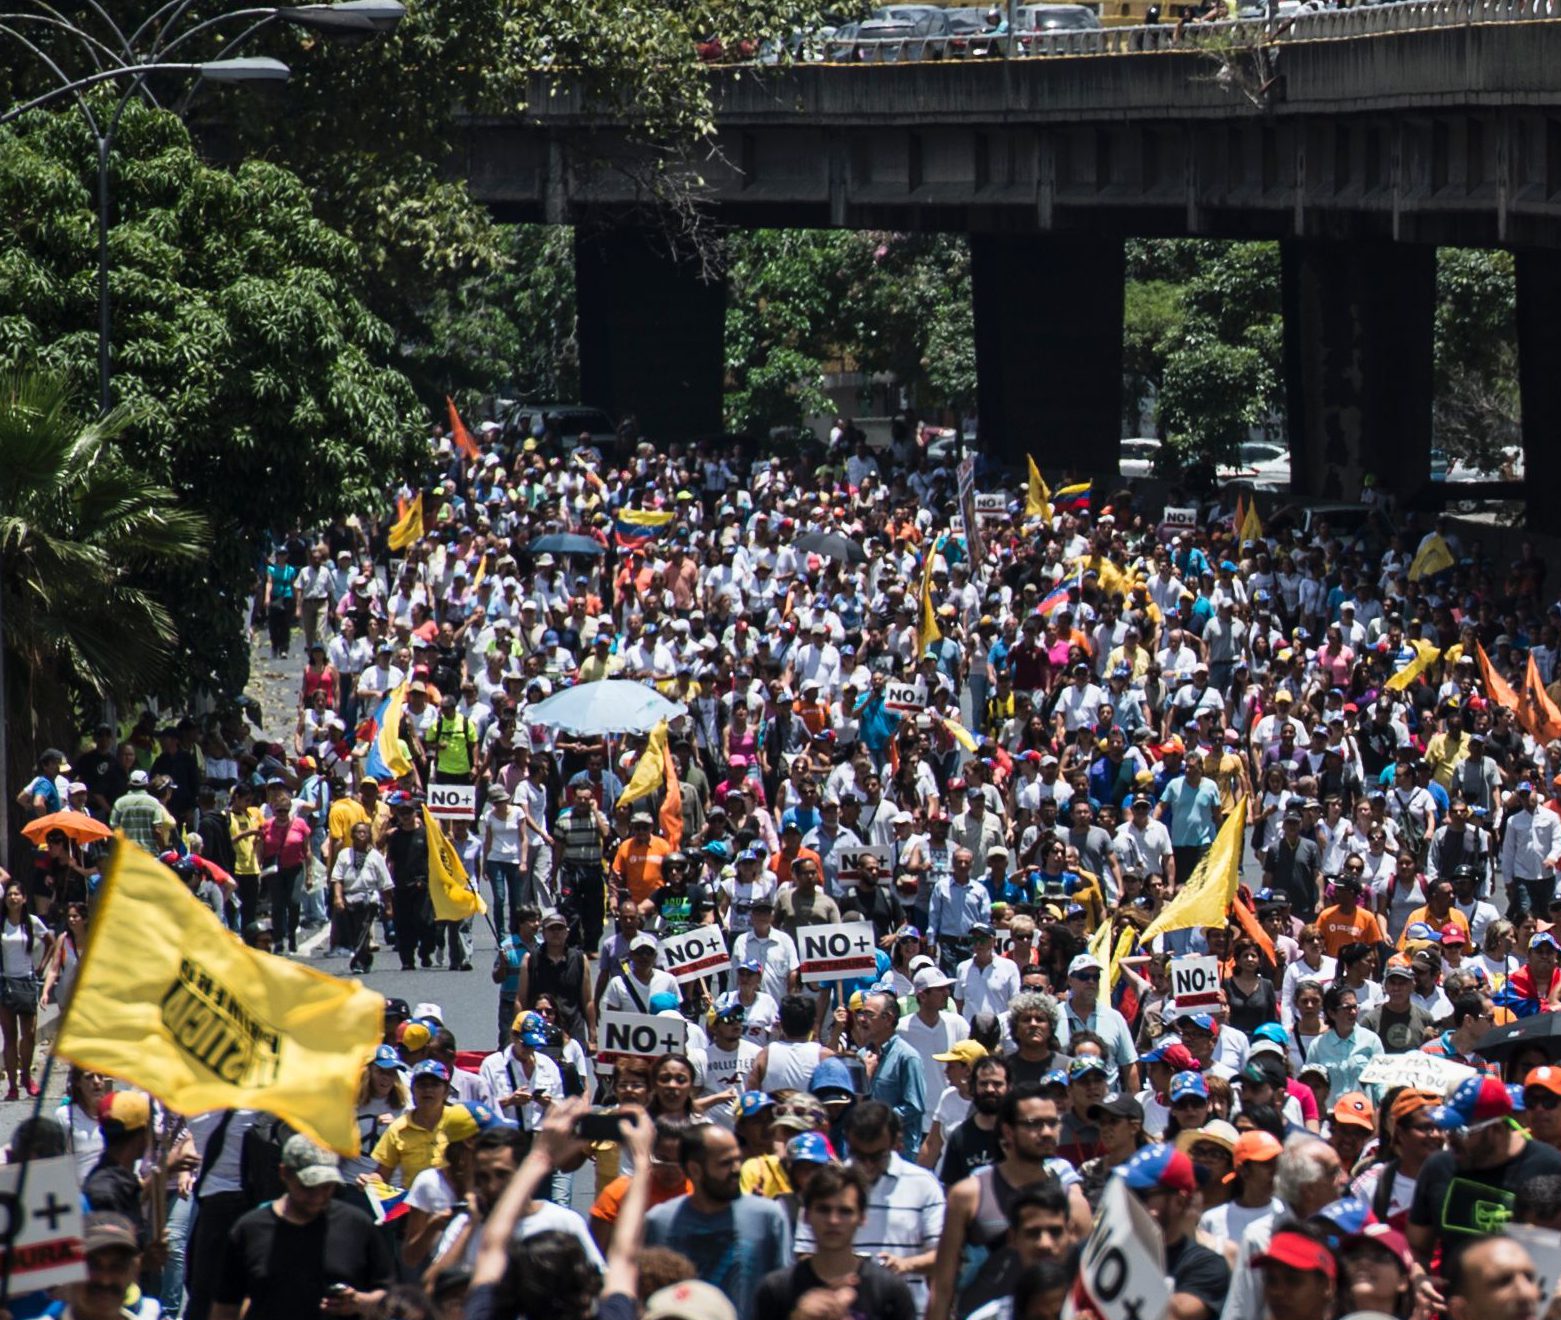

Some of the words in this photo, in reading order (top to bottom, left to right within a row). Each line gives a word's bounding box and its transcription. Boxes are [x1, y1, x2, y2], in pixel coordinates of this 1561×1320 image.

[890, 688, 924, 703] NO+
[431, 791, 471, 805] NO+
[842, 853, 888, 871] N+
[664, 937, 720, 966] NO+
[805, 933, 871, 959] NO+
[1177, 968, 1216, 993] NO+
[605, 1023, 680, 1053] NO+
